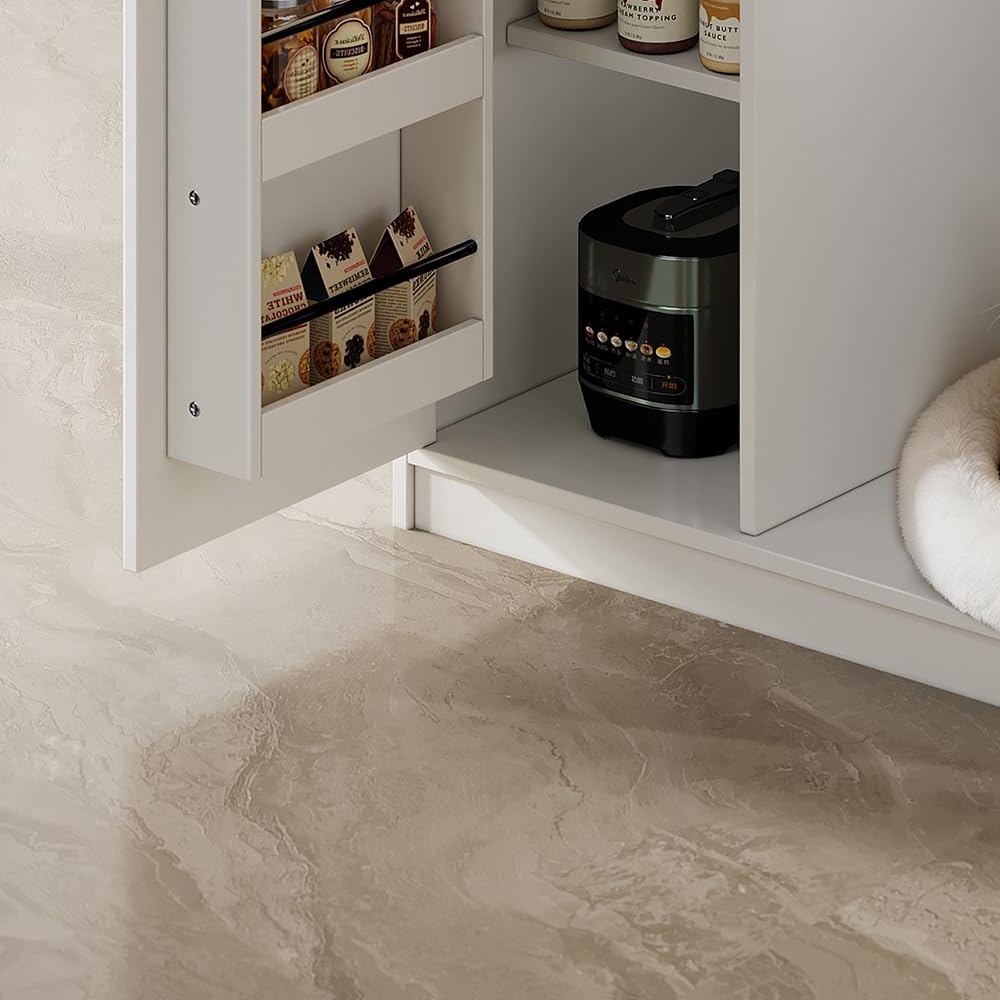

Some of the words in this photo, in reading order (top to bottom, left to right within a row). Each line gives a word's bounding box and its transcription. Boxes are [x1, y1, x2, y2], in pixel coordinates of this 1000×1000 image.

[620, 1, 661, 14] RAWBERRY
[636, 14, 677, 22] TOPPING
[716, 25, 739, 34] BUTT
[704, 30, 727, 42] SAUCE
